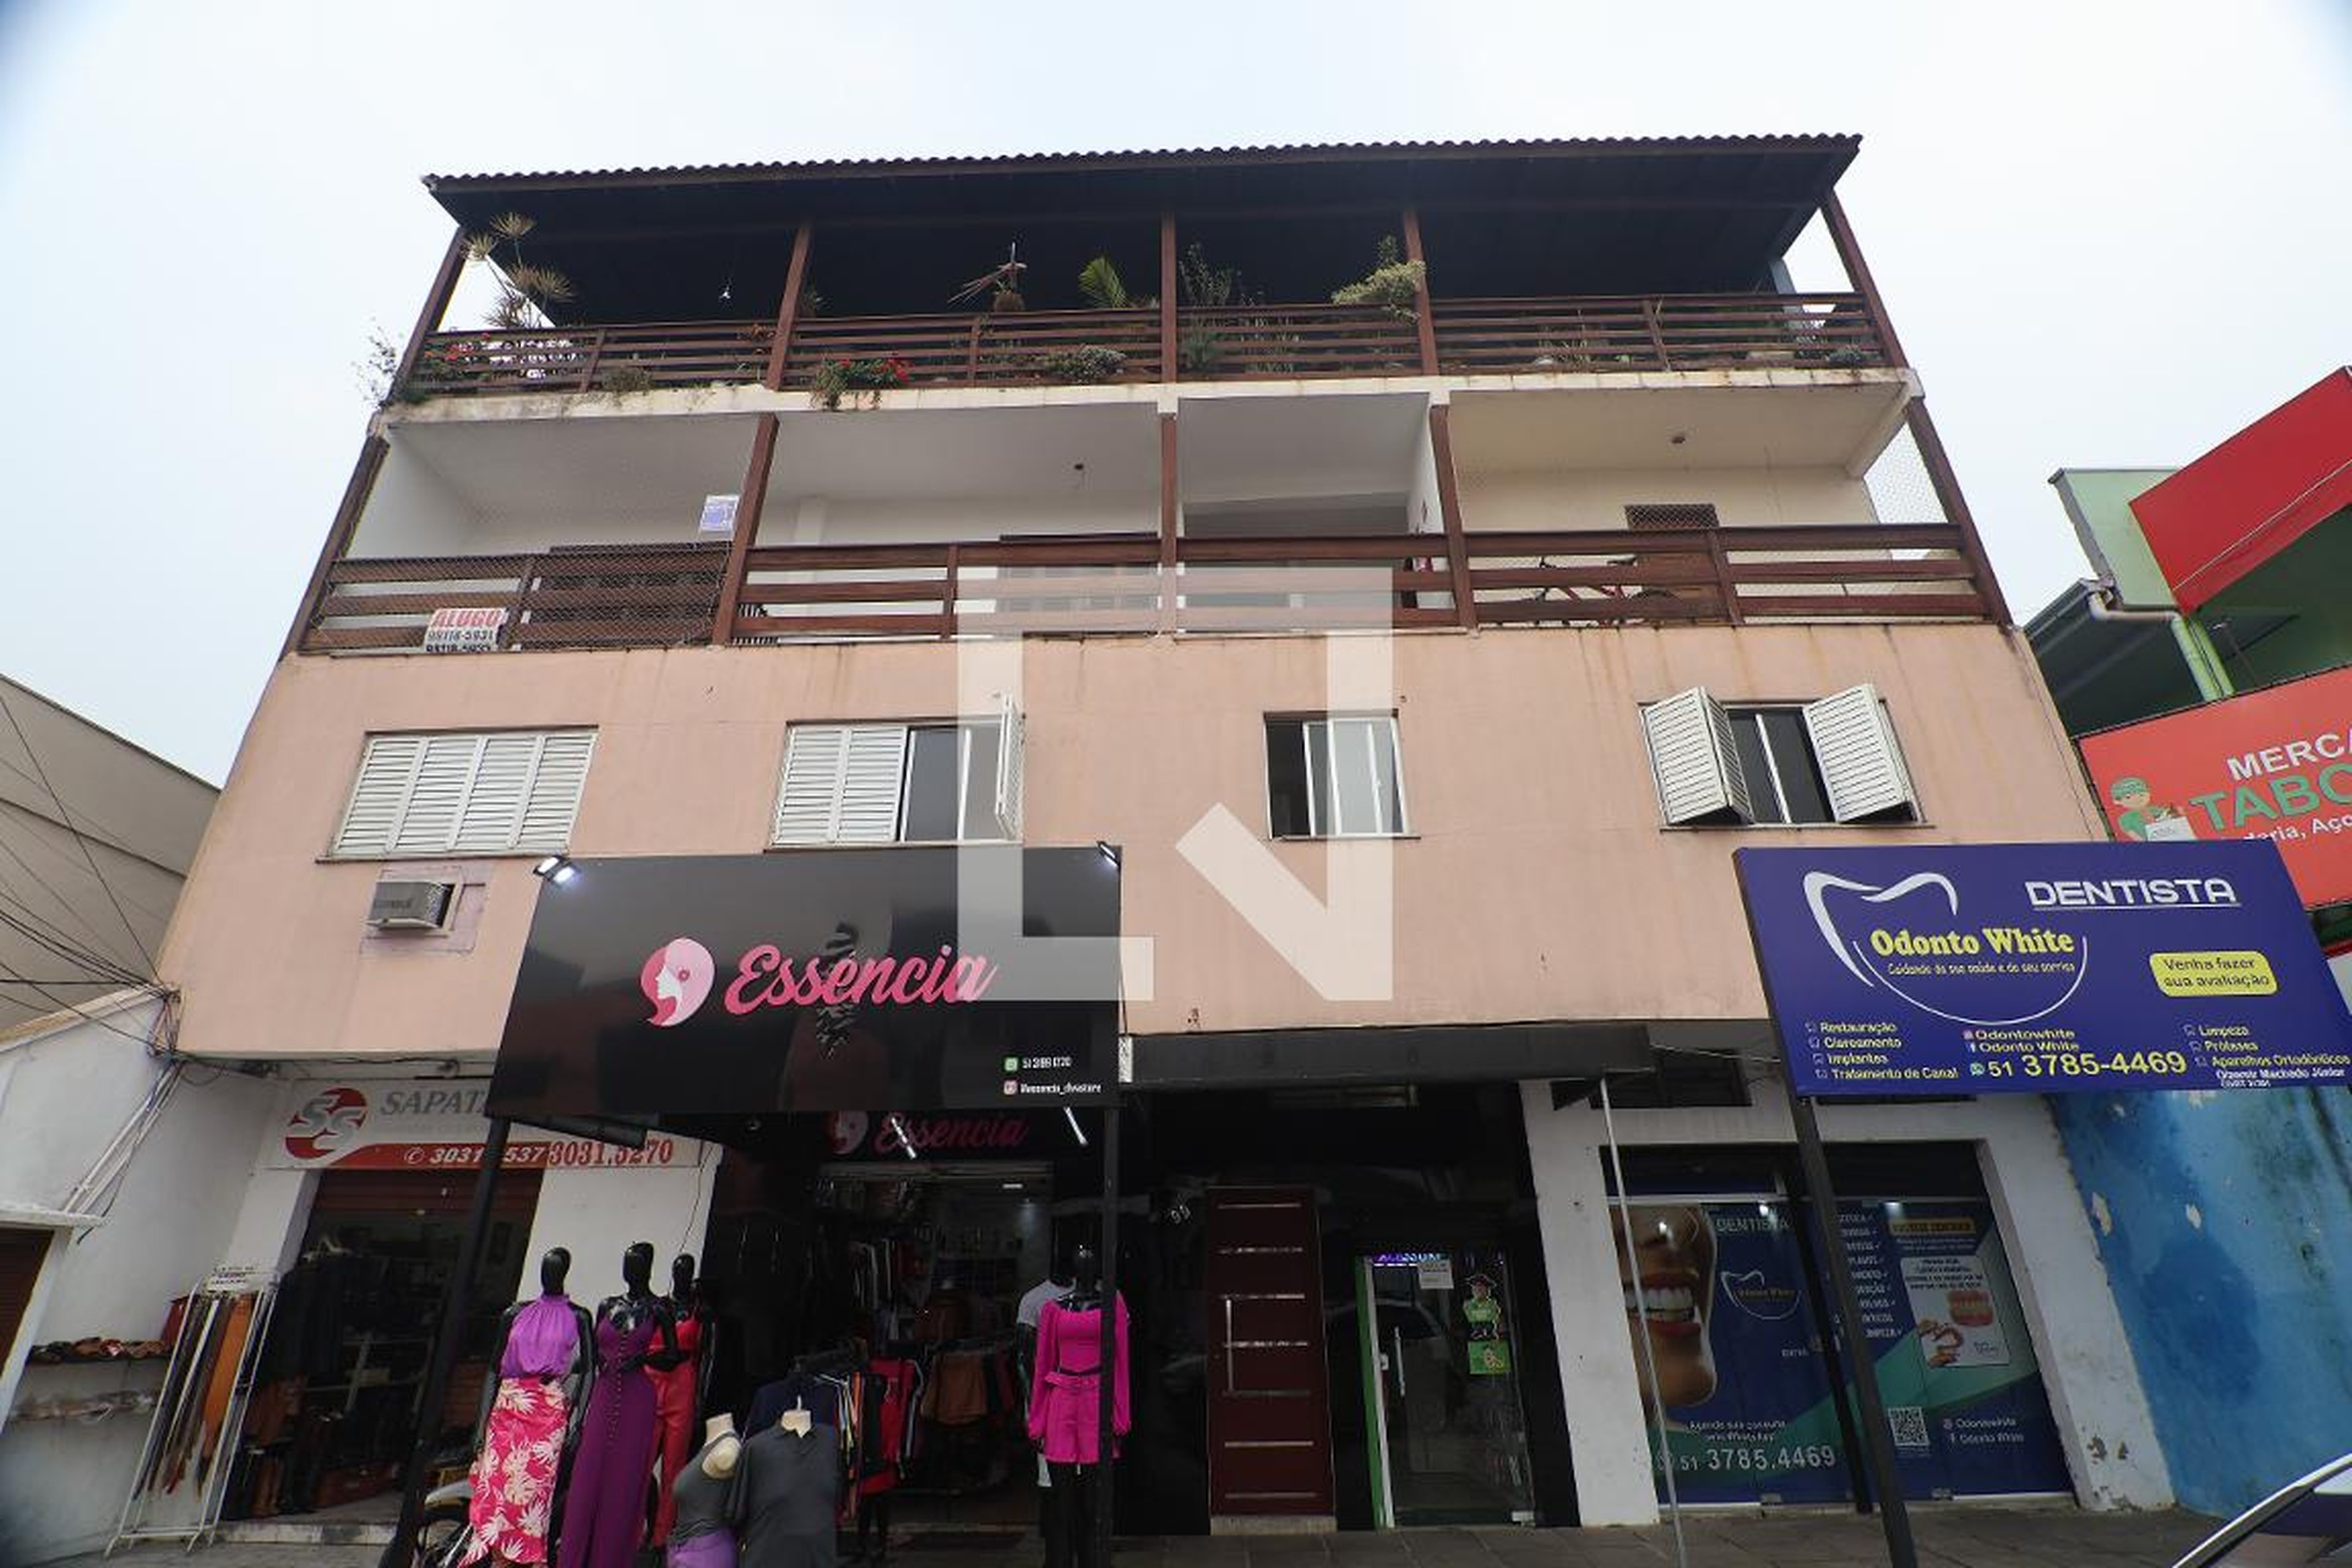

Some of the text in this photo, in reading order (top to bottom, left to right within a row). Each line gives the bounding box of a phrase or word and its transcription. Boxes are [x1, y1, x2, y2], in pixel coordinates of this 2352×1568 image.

[431, 611, 501, 627] ALUGO
[2024, 878, 2237, 906] DENTISTA
[1870, 927, 2075, 956] Odonto White
[2162, 957, 2255, 971] Venha fazer
[723, 944, 1000, 1016] Essencia
[2164, 974, 2270, 989] sua avaliação
[1820, 1022, 1896, 1035] Restauração
[2198, 1025, 2250, 1037] Limpeza
[1824, 1036, 1902, 1048] Clareamento
[1978, 1042, 2079, 1052] Odonto White
[1826, 1053, 1889, 1066] Implantes
[1988, 1051, 2187, 1077] 51 3785-4469
[2212, 1056, 2272, 1068] Aparelhos
[1831, 1067, 1959, 1079] Tratamento de Canal
[379, 1090, 488, 1115] SAPAT
[1680, 1445, 1836, 1470] 51 3785.4469
